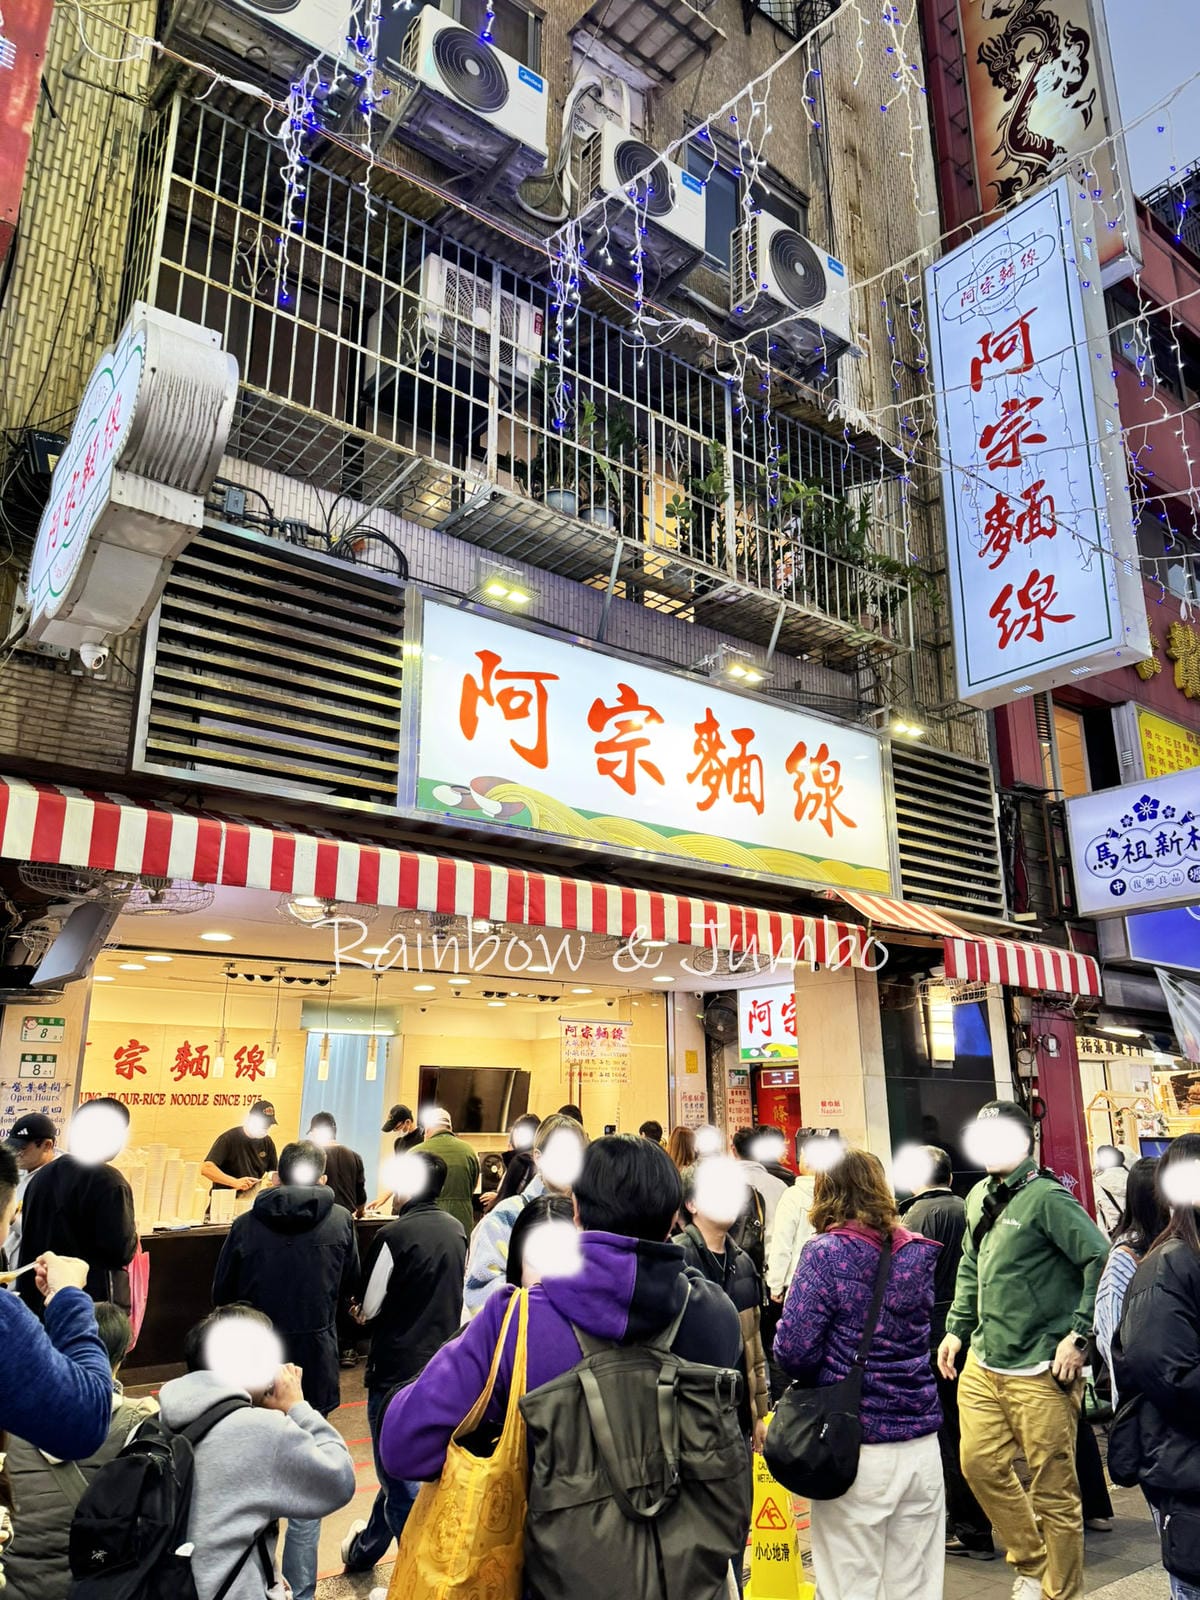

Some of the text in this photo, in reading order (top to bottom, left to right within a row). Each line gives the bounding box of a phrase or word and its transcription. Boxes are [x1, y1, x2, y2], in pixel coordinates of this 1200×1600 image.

[961, 248, 1040, 308] 阿宗麵線
[970, 306, 1076, 650] 阿宗麵線
[459, 649, 858, 838] 阿宗麵線
[40, 1027, 49, 1039] 8
[564, 1024, 627, 1041] 阿宗麵線
[86, 1038, 267, 1083] 宗麵線
[32, 1063, 42, 1076] 8
[770, 1071, 795, 1085] 二F
[10, 1092, 60, 1103] Open Hours
[170, 1093, 209, 1106] NOODLE
[213, 1094, 241, 1107] SINCE
[755, 1542, 790, 1562] 小心地滑
